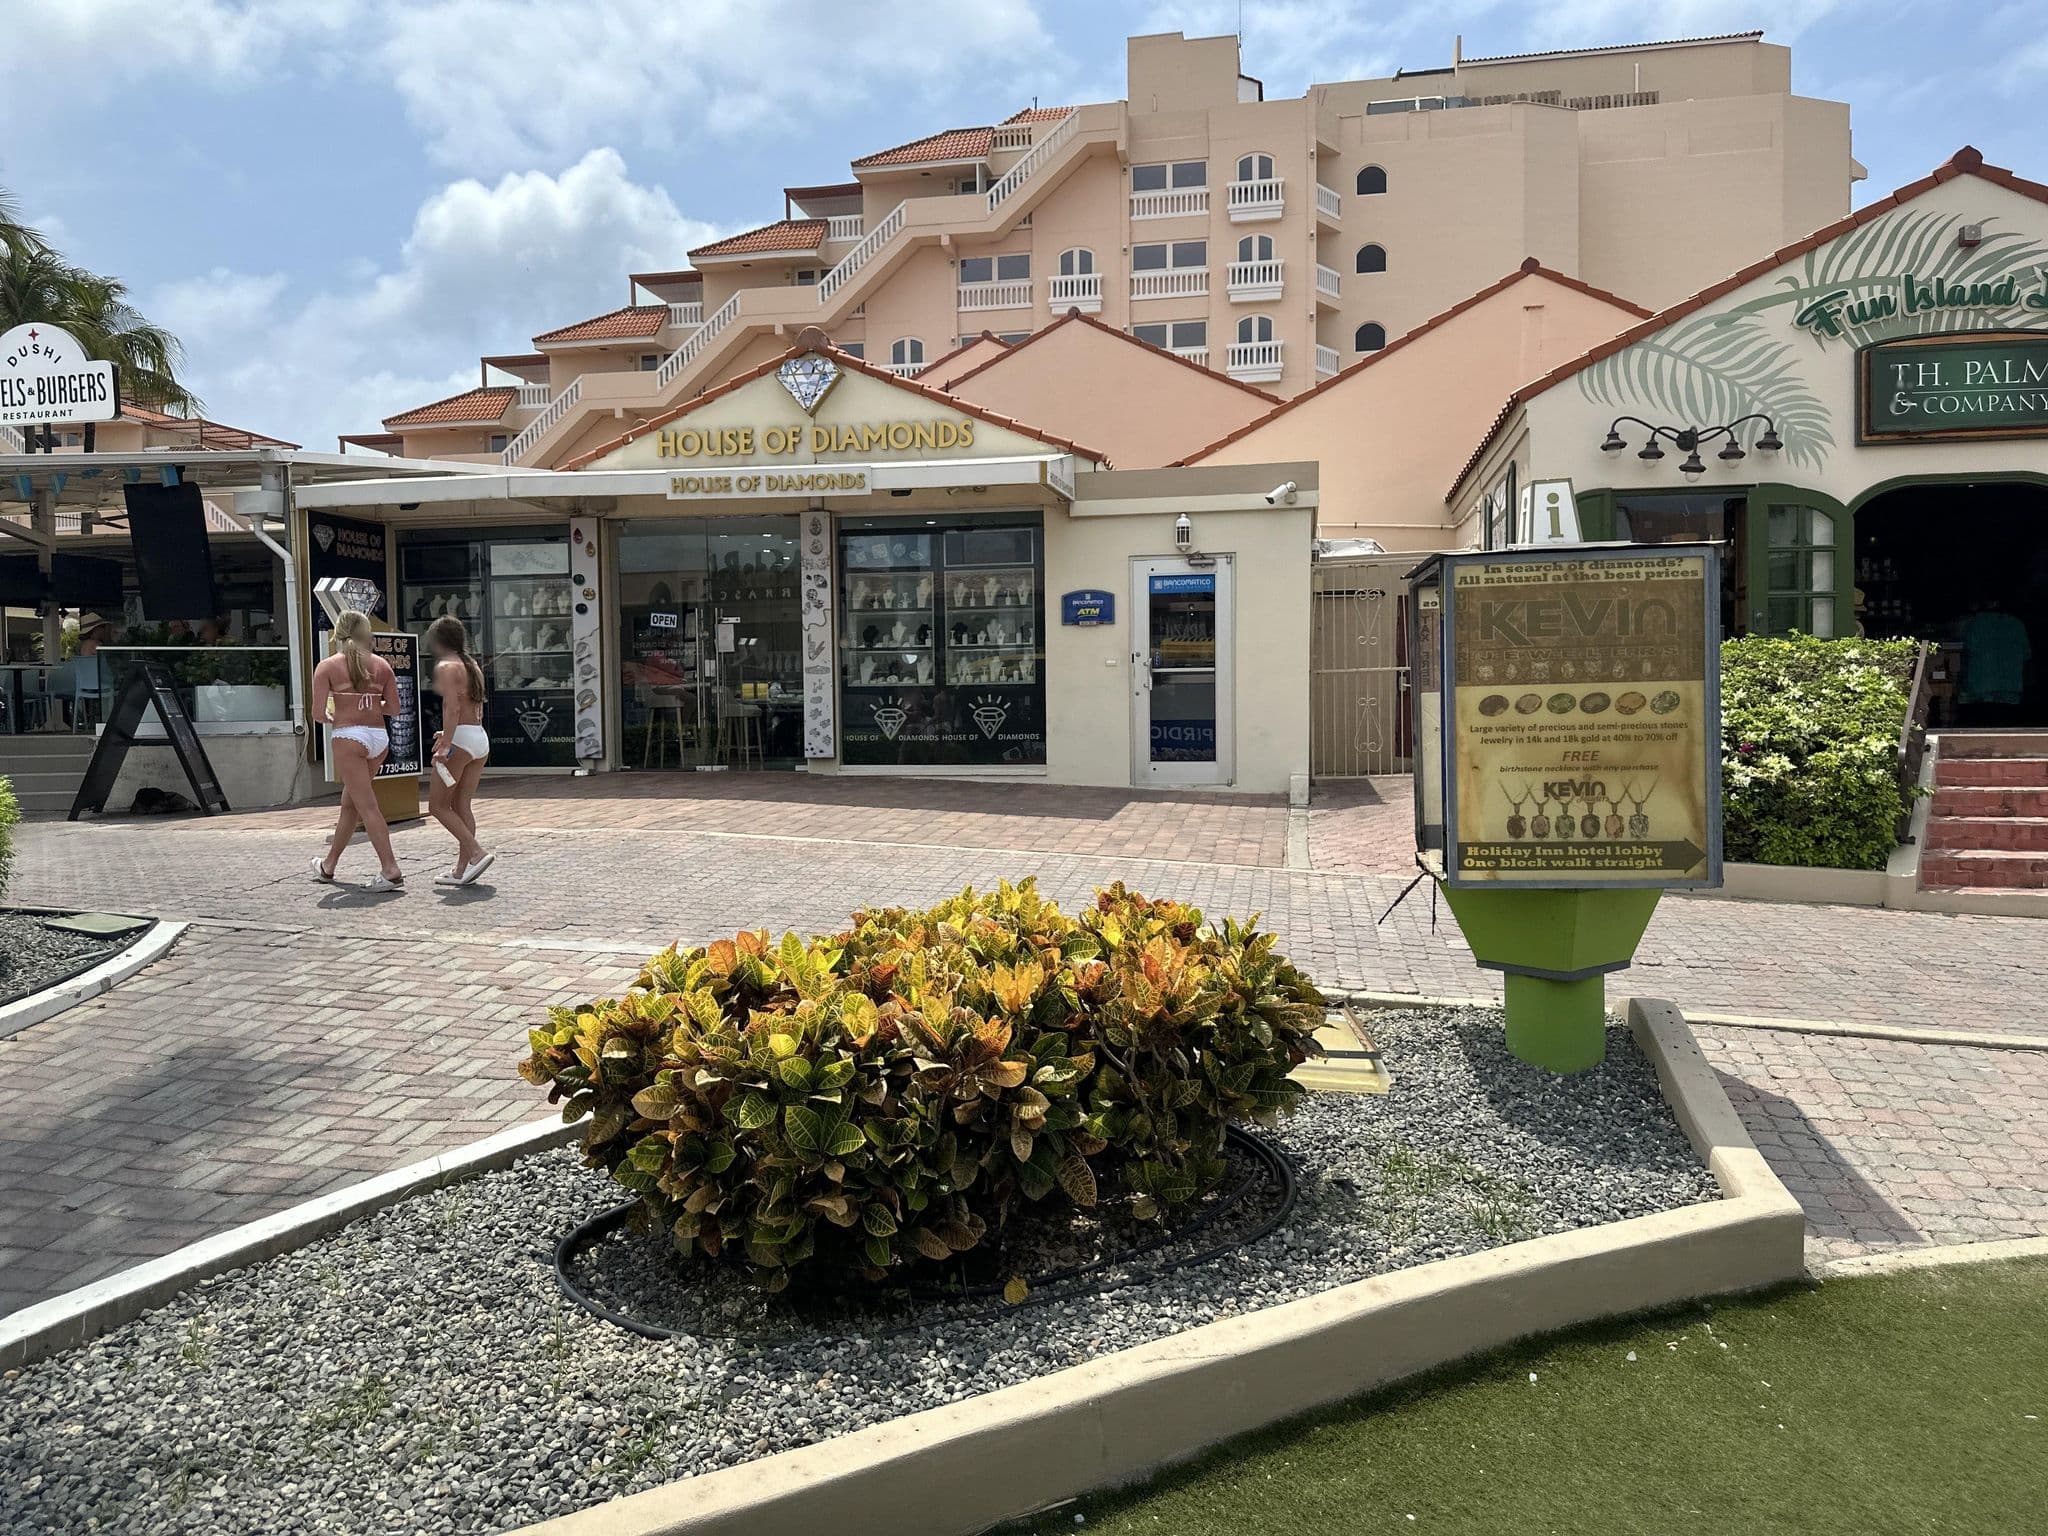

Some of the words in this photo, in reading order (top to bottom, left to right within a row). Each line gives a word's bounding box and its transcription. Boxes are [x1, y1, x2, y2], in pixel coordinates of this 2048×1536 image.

[1796, 289, 1897, 338] Fun
[1901, 273, 2020, 315] Island
[7, 344, 61, 367] DUSHI
[1964, 359, 2048, 385] PALM
[27, 387, 35, 396] &
[37, 372, 106, 405] BURGERS
[1889, 391, 1918, 415] &
[1923, 394, 2048, 414] COMPANY
[3, 409, 73, 420] RESTAURANT
[656, 428, 754, 457] HOUSE
[762, 427, 801, 455] OF
[811, 419, 975, 454] DIAMONDS
[671, 476, 731, 494] HOUSE
[736, 475, 760, 492] OF
[766, 473, 866, 491] DIAMONDS
[338, 528, 368, 546] HOUSE
[369, 534, 381, 547] OF
[337, 542, 384, 562] DIAMONDS
[1484, 564, 1502, 574] In
[1505, 562, 1563, 573] search
[1568, 560, 1584, 572] of
[1588, 557, 1683, 570] diamonds?
[1458, 576, 1480, 585] All
[1484, 573, 1548, 584] natural
[1552, 573, 1568, 582] at
[1573, 570, 1600, 581] the
[1604, 570, 1640, 580] best
[1644, 568, 1698, 581] prices
[652, 615, 675, 625] OPEN
[394, 638, 408, 654] OF
[1470, 725, 1493, 734] Large
[1495, 724, 1525, 733] variety
[1539, 724, 1576, 732] precious
[1597, 722, 1658, 731] semi-precious
[1661, 721, 1688, 729] stones
[1480, 736, 1512, 745] Jewelry
[1526, 736, 1542, 744] 14k
[1544, 735, 1561, 743] and
[1581, 734, 1599, 743] gold
[1602, 734, 1611, 742] at
[1613, 733, 1631, 741] 40%
[1646, 733, 1663, 741] 70%
[1665, 733, 1678, 741] off
[1562, 751, 1600, 762] FREE
[385, 762, 418, 774] 730-4653
[1583, 764, 1601, 772] with
[1621, 764, 1659, 772] purchase
[1466, 846, 1531, 858] Holiday
[1535, 846, 1563, 856] Inn
[1567, 846, 1611, 856] hotel
[1615, 846, 1664, 857] lobby
[1464, 858, 1496, 867] One
[1500, 858, 1547, 867] block
[1551, 857, 1591, 867] walk
[1595, 857, 1664, 868] straight
